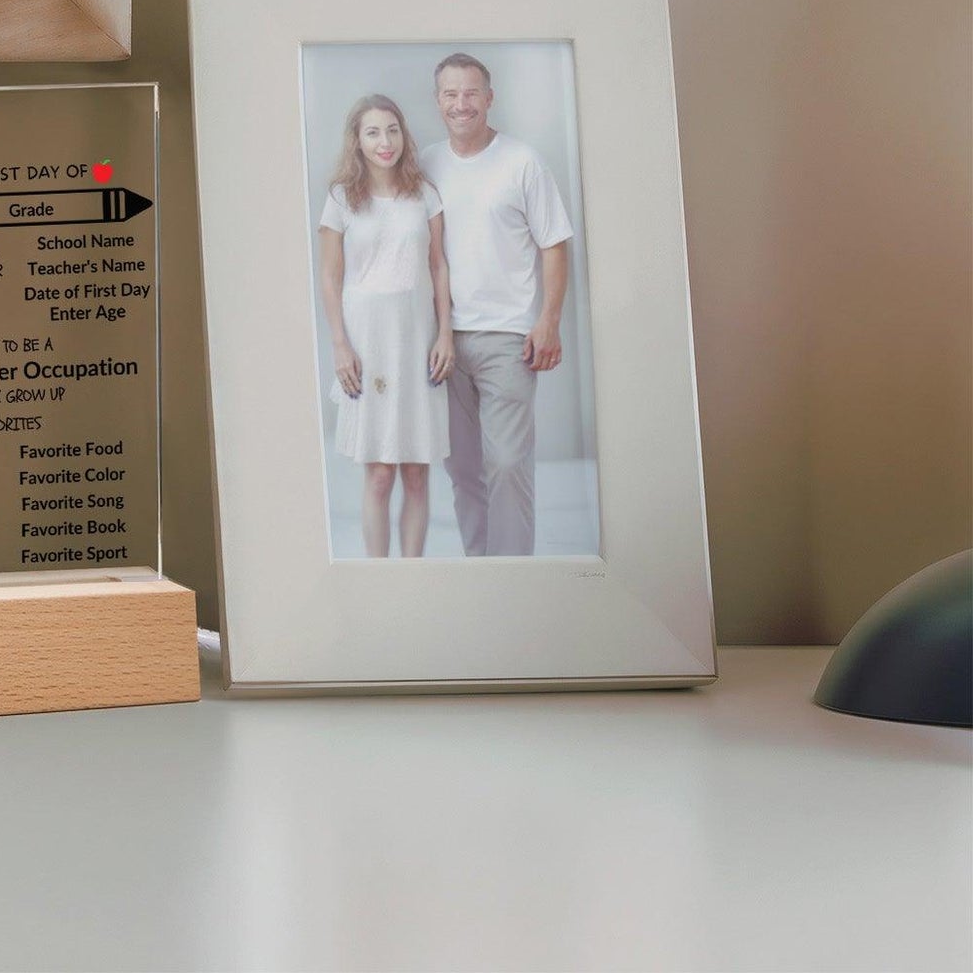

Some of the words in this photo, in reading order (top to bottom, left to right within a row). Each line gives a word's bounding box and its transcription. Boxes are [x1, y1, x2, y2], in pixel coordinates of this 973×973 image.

[27, 166, 59, 179] DAY
[67, 164, 87, 178] OF
[9, 202, 53, 217] Grade
[38, 235, 86, 250] School
[92, 234, 134, 247] Name
[27, 260, 98, 275] Teacher's
[102, 259, 145, 272] Name
[25, 287, 60, 300] Date
[65, 285, 79, 299] of
[84, 284, 116, 298] First
[122, 283, 150, 298] Day
[51, 307, 91, 321] Enter
[96, 305, 126, 321] Age
[2, 340, 18, 353] TO
[24, 338, 39, 352] BE
[45, 337, 53, 351] A
[24, 357, 137, 380] Occupation
[6, 389, 45, 403] GROW
[50, 387, 65, 401] UP
[20, 444, 81, 458] Favorite
[86, 441, 122, 455] Food
[20, 470, 81, 485] Favorite
[85, 467, 125, 482] Color
[22, 496, 83, 511] Favorite
[88, 494, 124, 509] Song
[22, 522, 83, 537] Favorite
[88, 519, 126, 534] Book
[22, 548, 83, 563] Favorite
[87, 546, 127, 562] Sport
